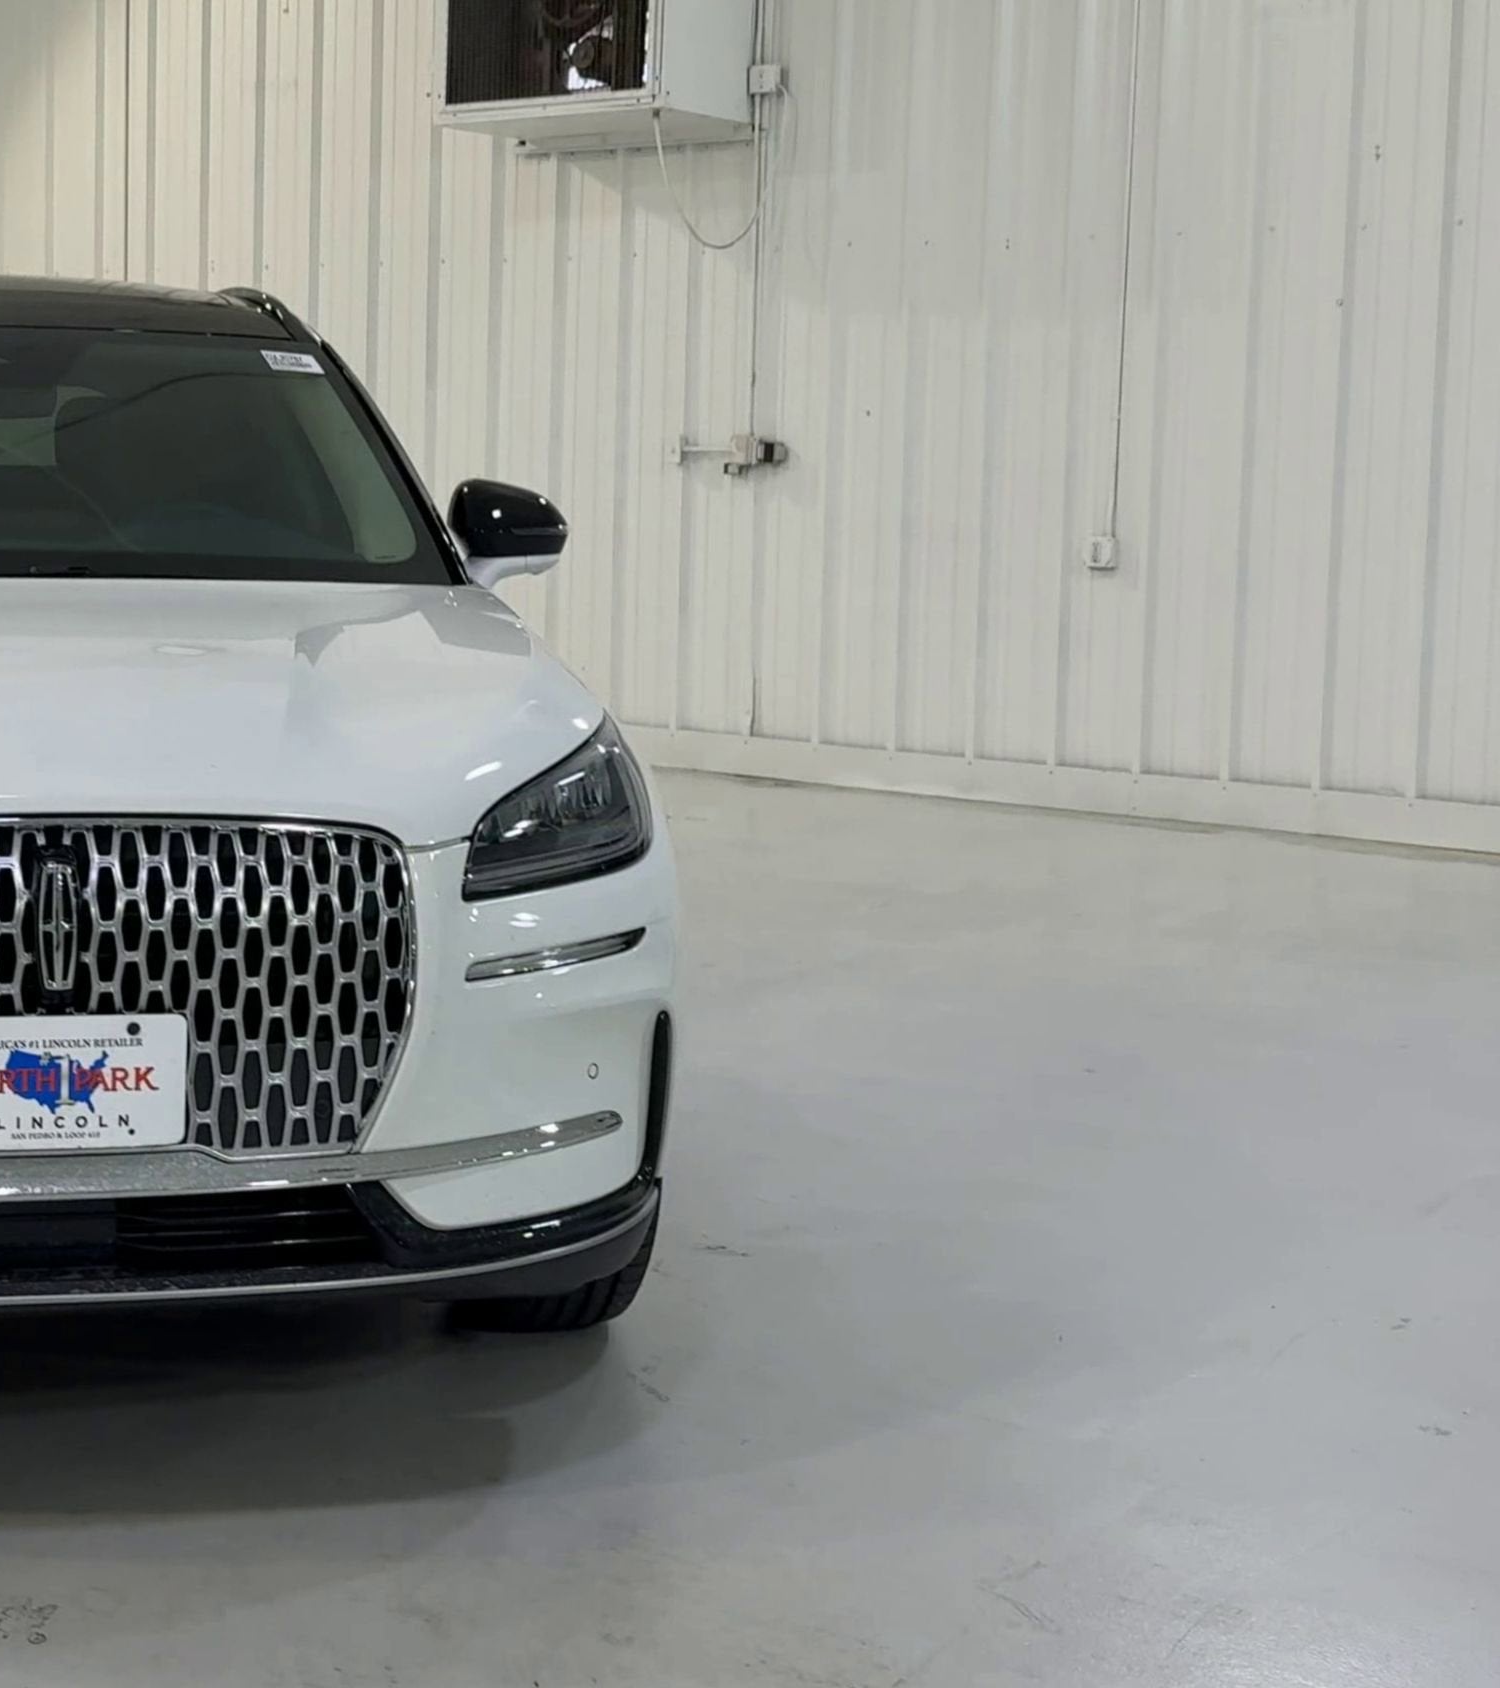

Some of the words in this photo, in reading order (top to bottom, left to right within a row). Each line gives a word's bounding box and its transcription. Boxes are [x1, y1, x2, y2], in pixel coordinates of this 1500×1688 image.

[28, 1039, 40, 1049] #1
[42, 1038, 92, 1049] LINCOLN
[93, 1037, 144, 1048] RETAILER
[75, 1066, 160, 1093] PARK
